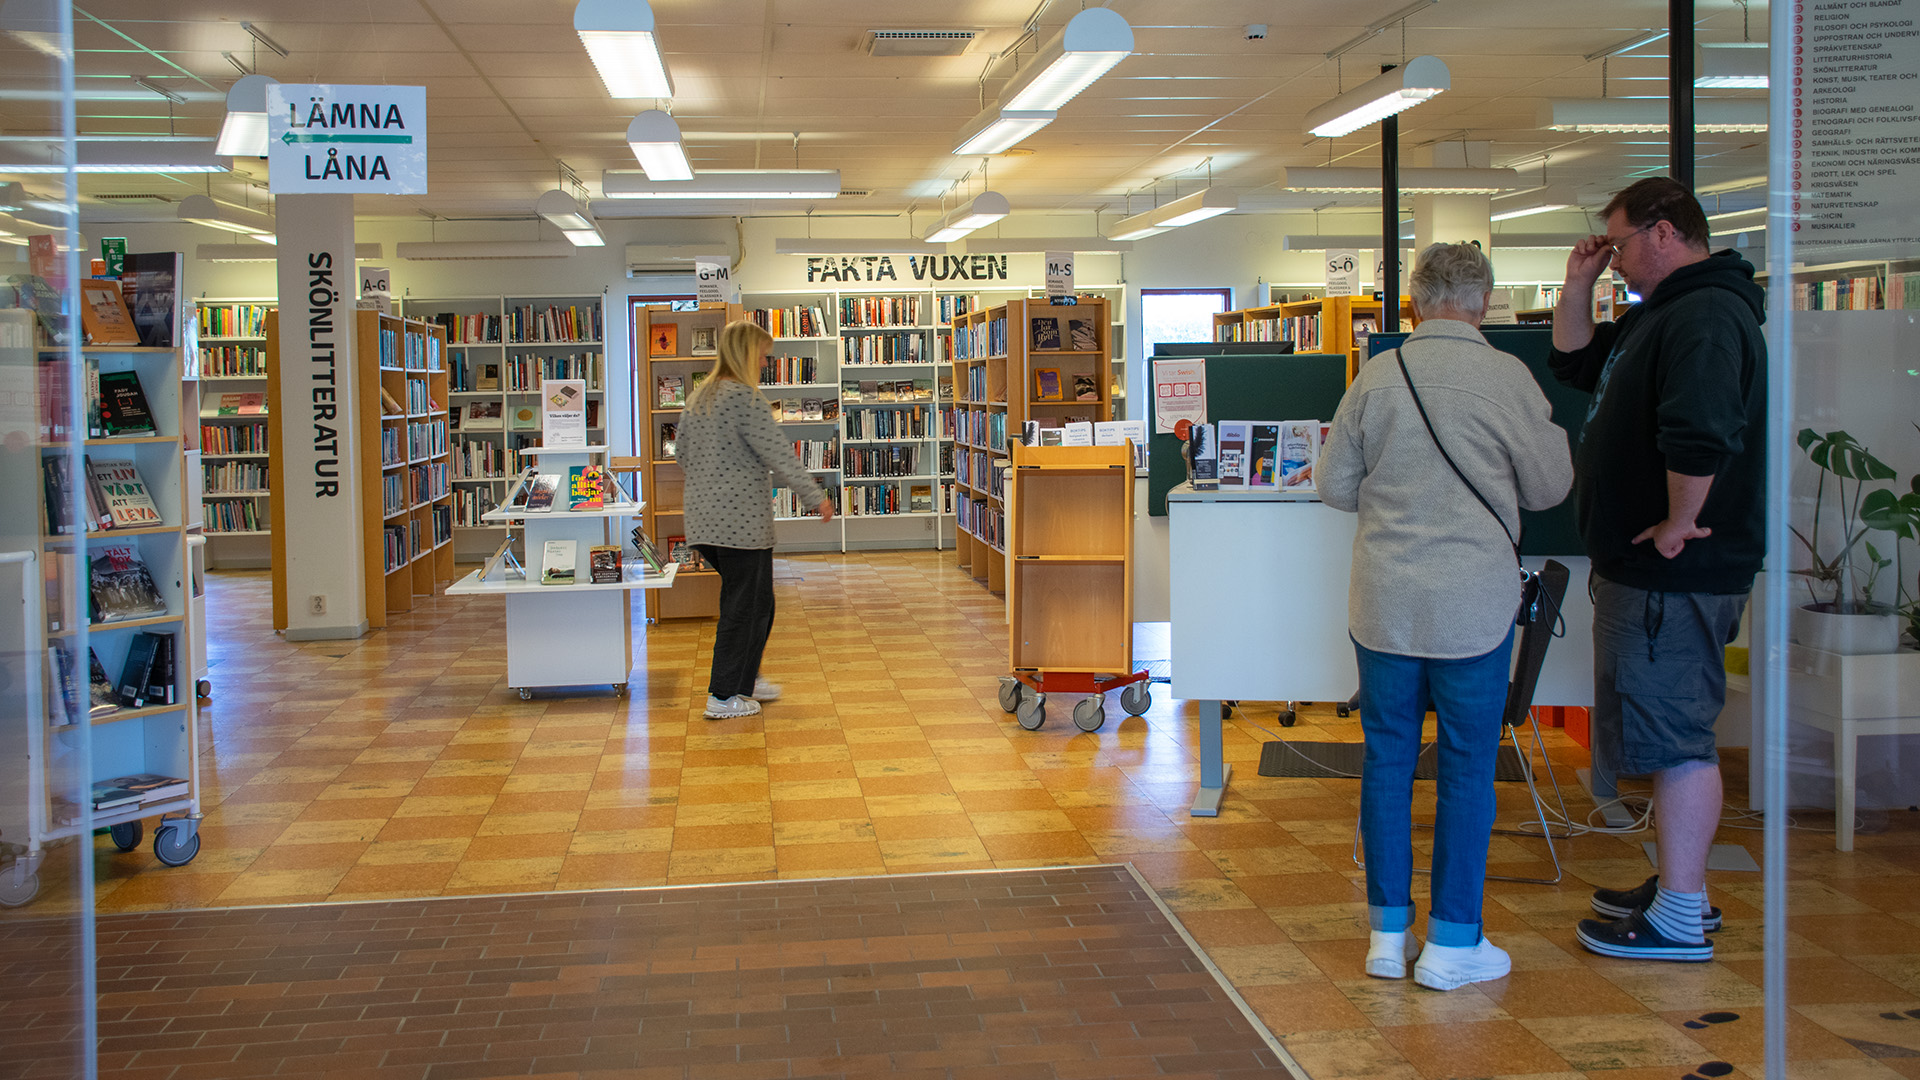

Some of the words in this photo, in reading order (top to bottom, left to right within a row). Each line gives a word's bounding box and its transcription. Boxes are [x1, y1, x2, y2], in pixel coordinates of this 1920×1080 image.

[1814, 44, 1882, 52] SPRÅKVETENSKAP
[1813, 53, 1892, 63] LITTERATURHISTORIA
[1813, 64, 1877, 73] SKÖNLITTERATUR
[290, 97, 405, 129] LÄMNA
[305, 148, 391, 180] LÅNA
[808, 256, 897, 282] FAKTA
[909, 255, 1007, 280] VUXEN
[1049, 263, 1071, 276] M-S
[1329, 258, 1353, 272] S-Ö
[700, 268, 728, 280] G-M
[363, 279, 386, 291] A-G
[308, 252, 339, 498] SKÖNLITTERATUR
[113, 469, 136, 480] LIV
[103, 482, 144, 496] VÄRT
[116, 508, 159, 521] LEVA
[108, 556, 132, 564] BOK
